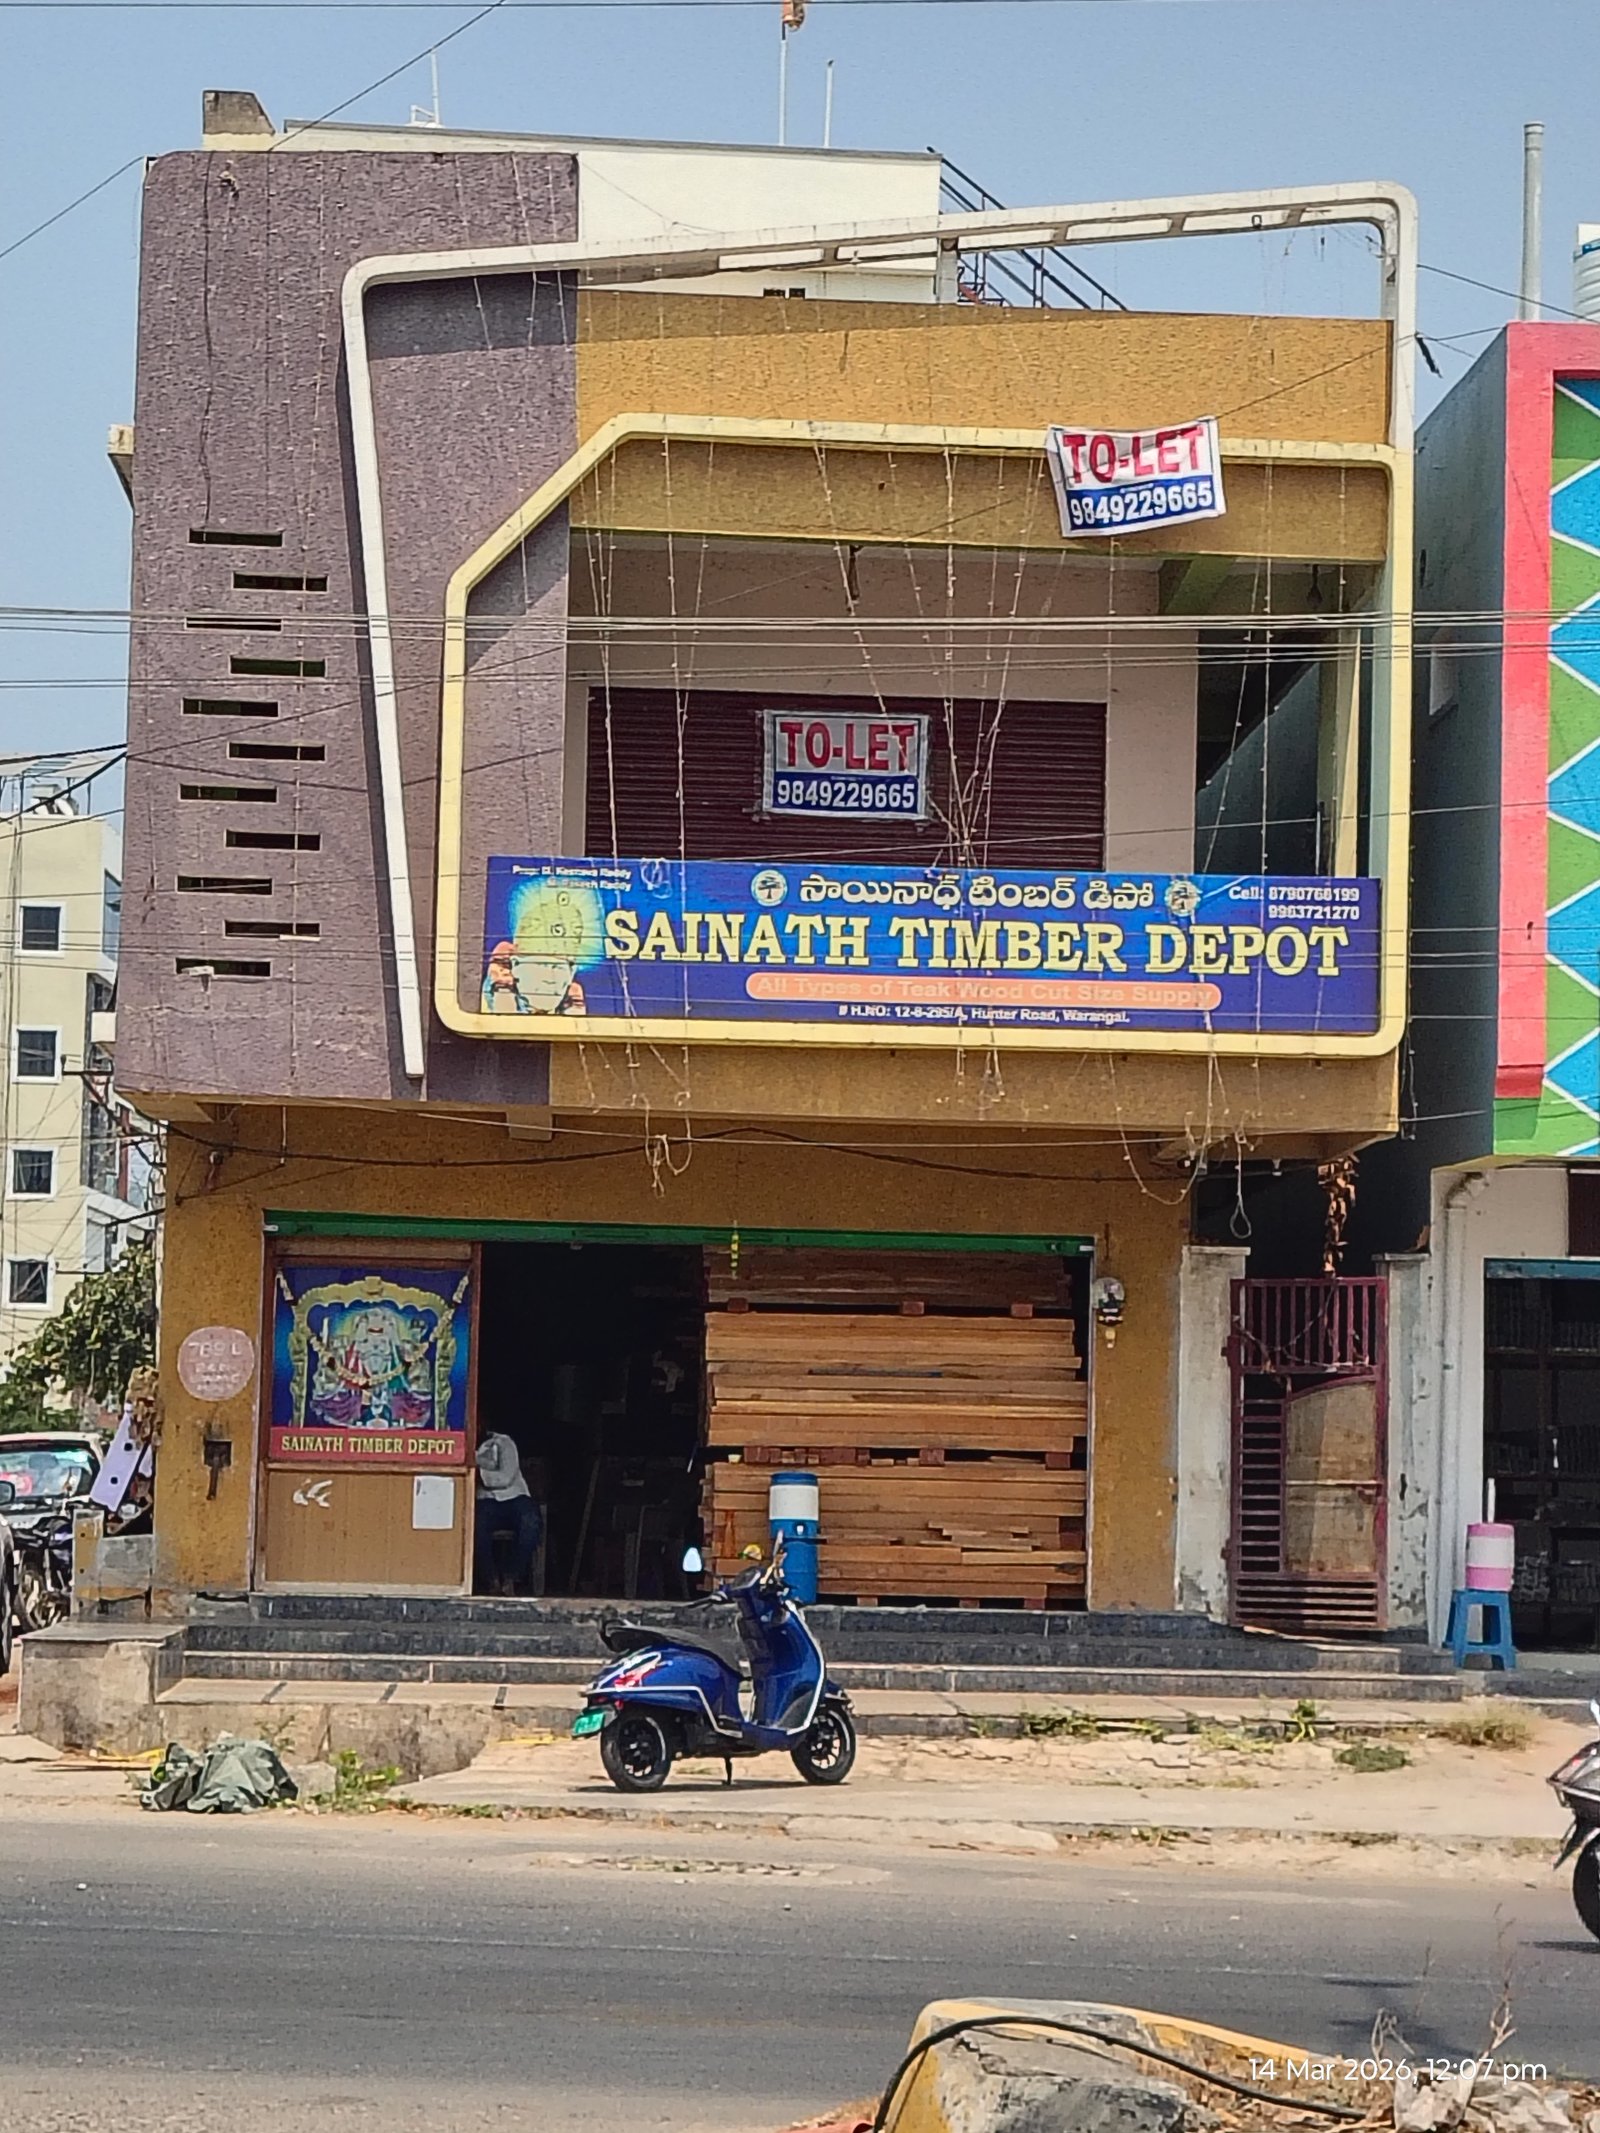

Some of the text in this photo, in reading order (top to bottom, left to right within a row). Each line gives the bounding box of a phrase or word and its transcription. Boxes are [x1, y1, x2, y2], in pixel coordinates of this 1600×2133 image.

[1063, 425, 1204, 484] TO-LET
[1070, 481, 1212, 526] 9849229665
[779, 721, 915, 771] TO-LET
[777, 780, 915, 808] 9849229665
[604, 909, 1349, 976] SAINATH TIMBER DEPOT
[757, 977, 1212, 1006] All Types of Teak Wood Cut Size Supply
[281, 1435, 456, 1455] SAINATH TIMBER DEPOT
